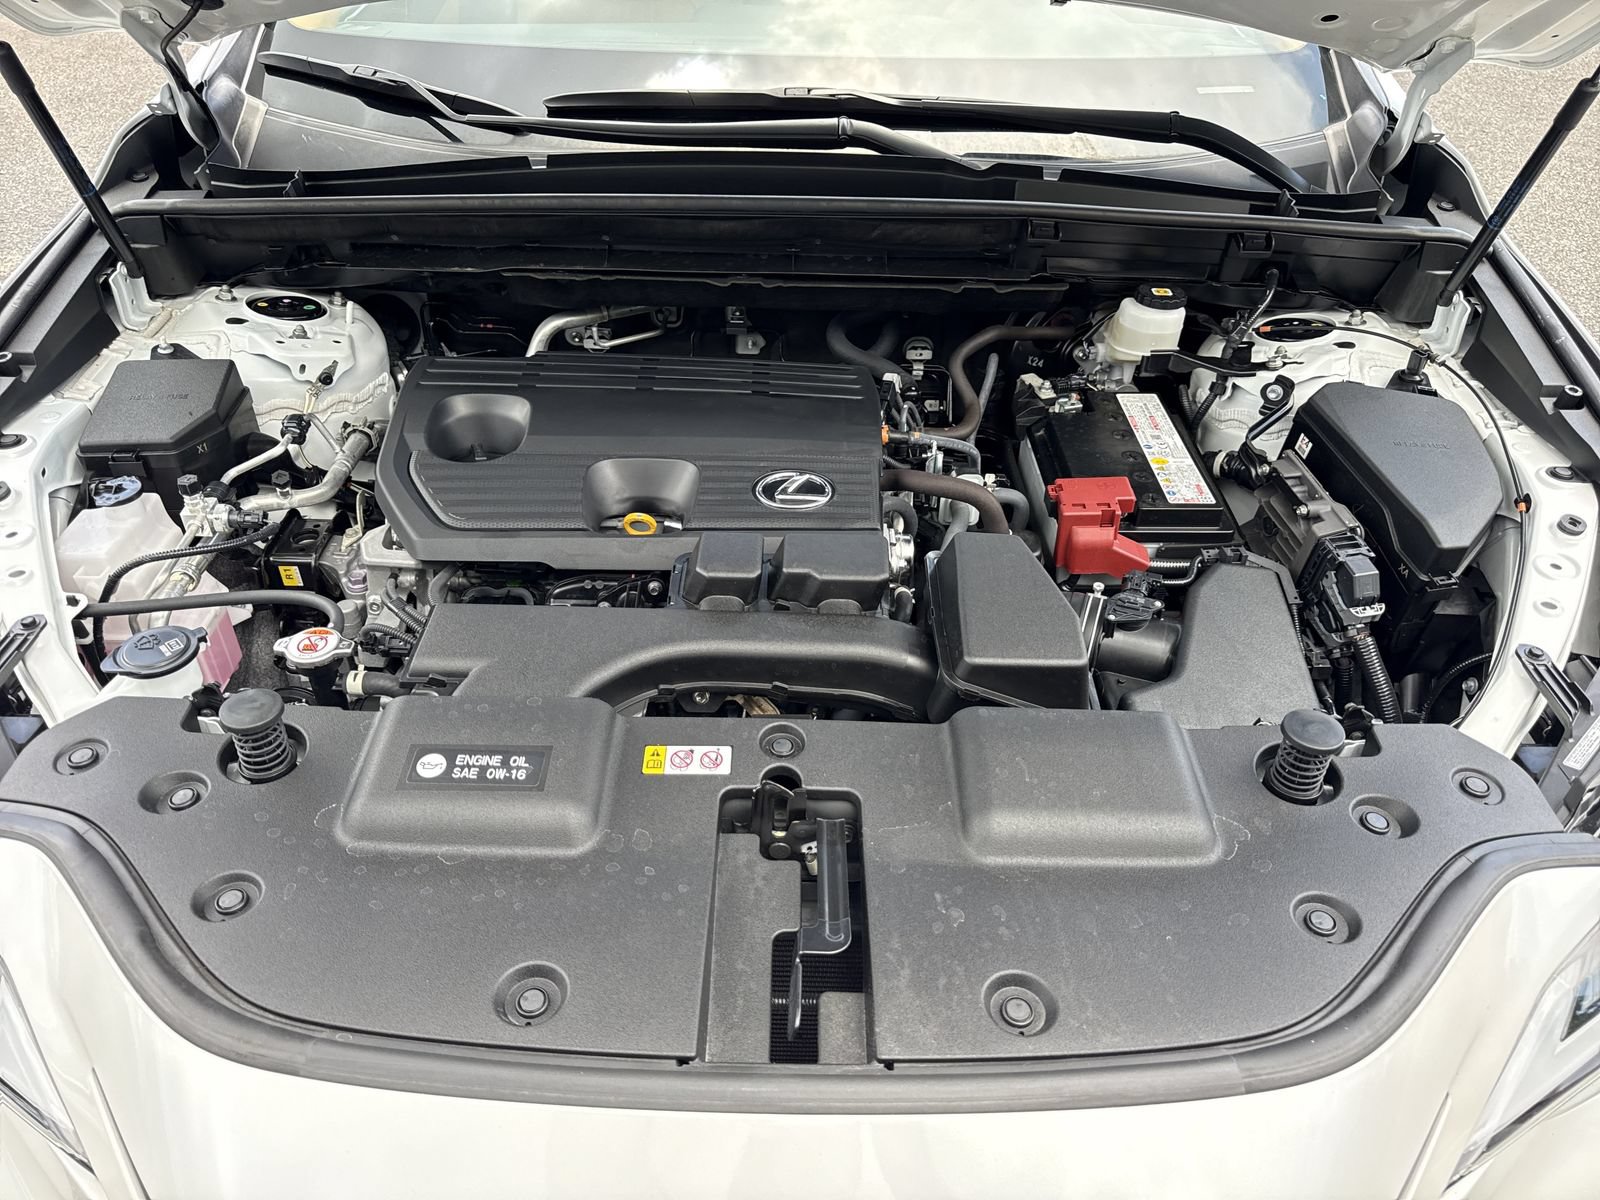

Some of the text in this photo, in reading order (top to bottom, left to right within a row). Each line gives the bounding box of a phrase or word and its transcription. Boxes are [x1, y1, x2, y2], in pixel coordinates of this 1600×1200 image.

[1027, 356, 1044, 368] X24
[196, 442, 209, 455] X1
[455, 754, 530, 767] ENGINE OIL
[451, 767, 527, 780] SAE 0W-16
